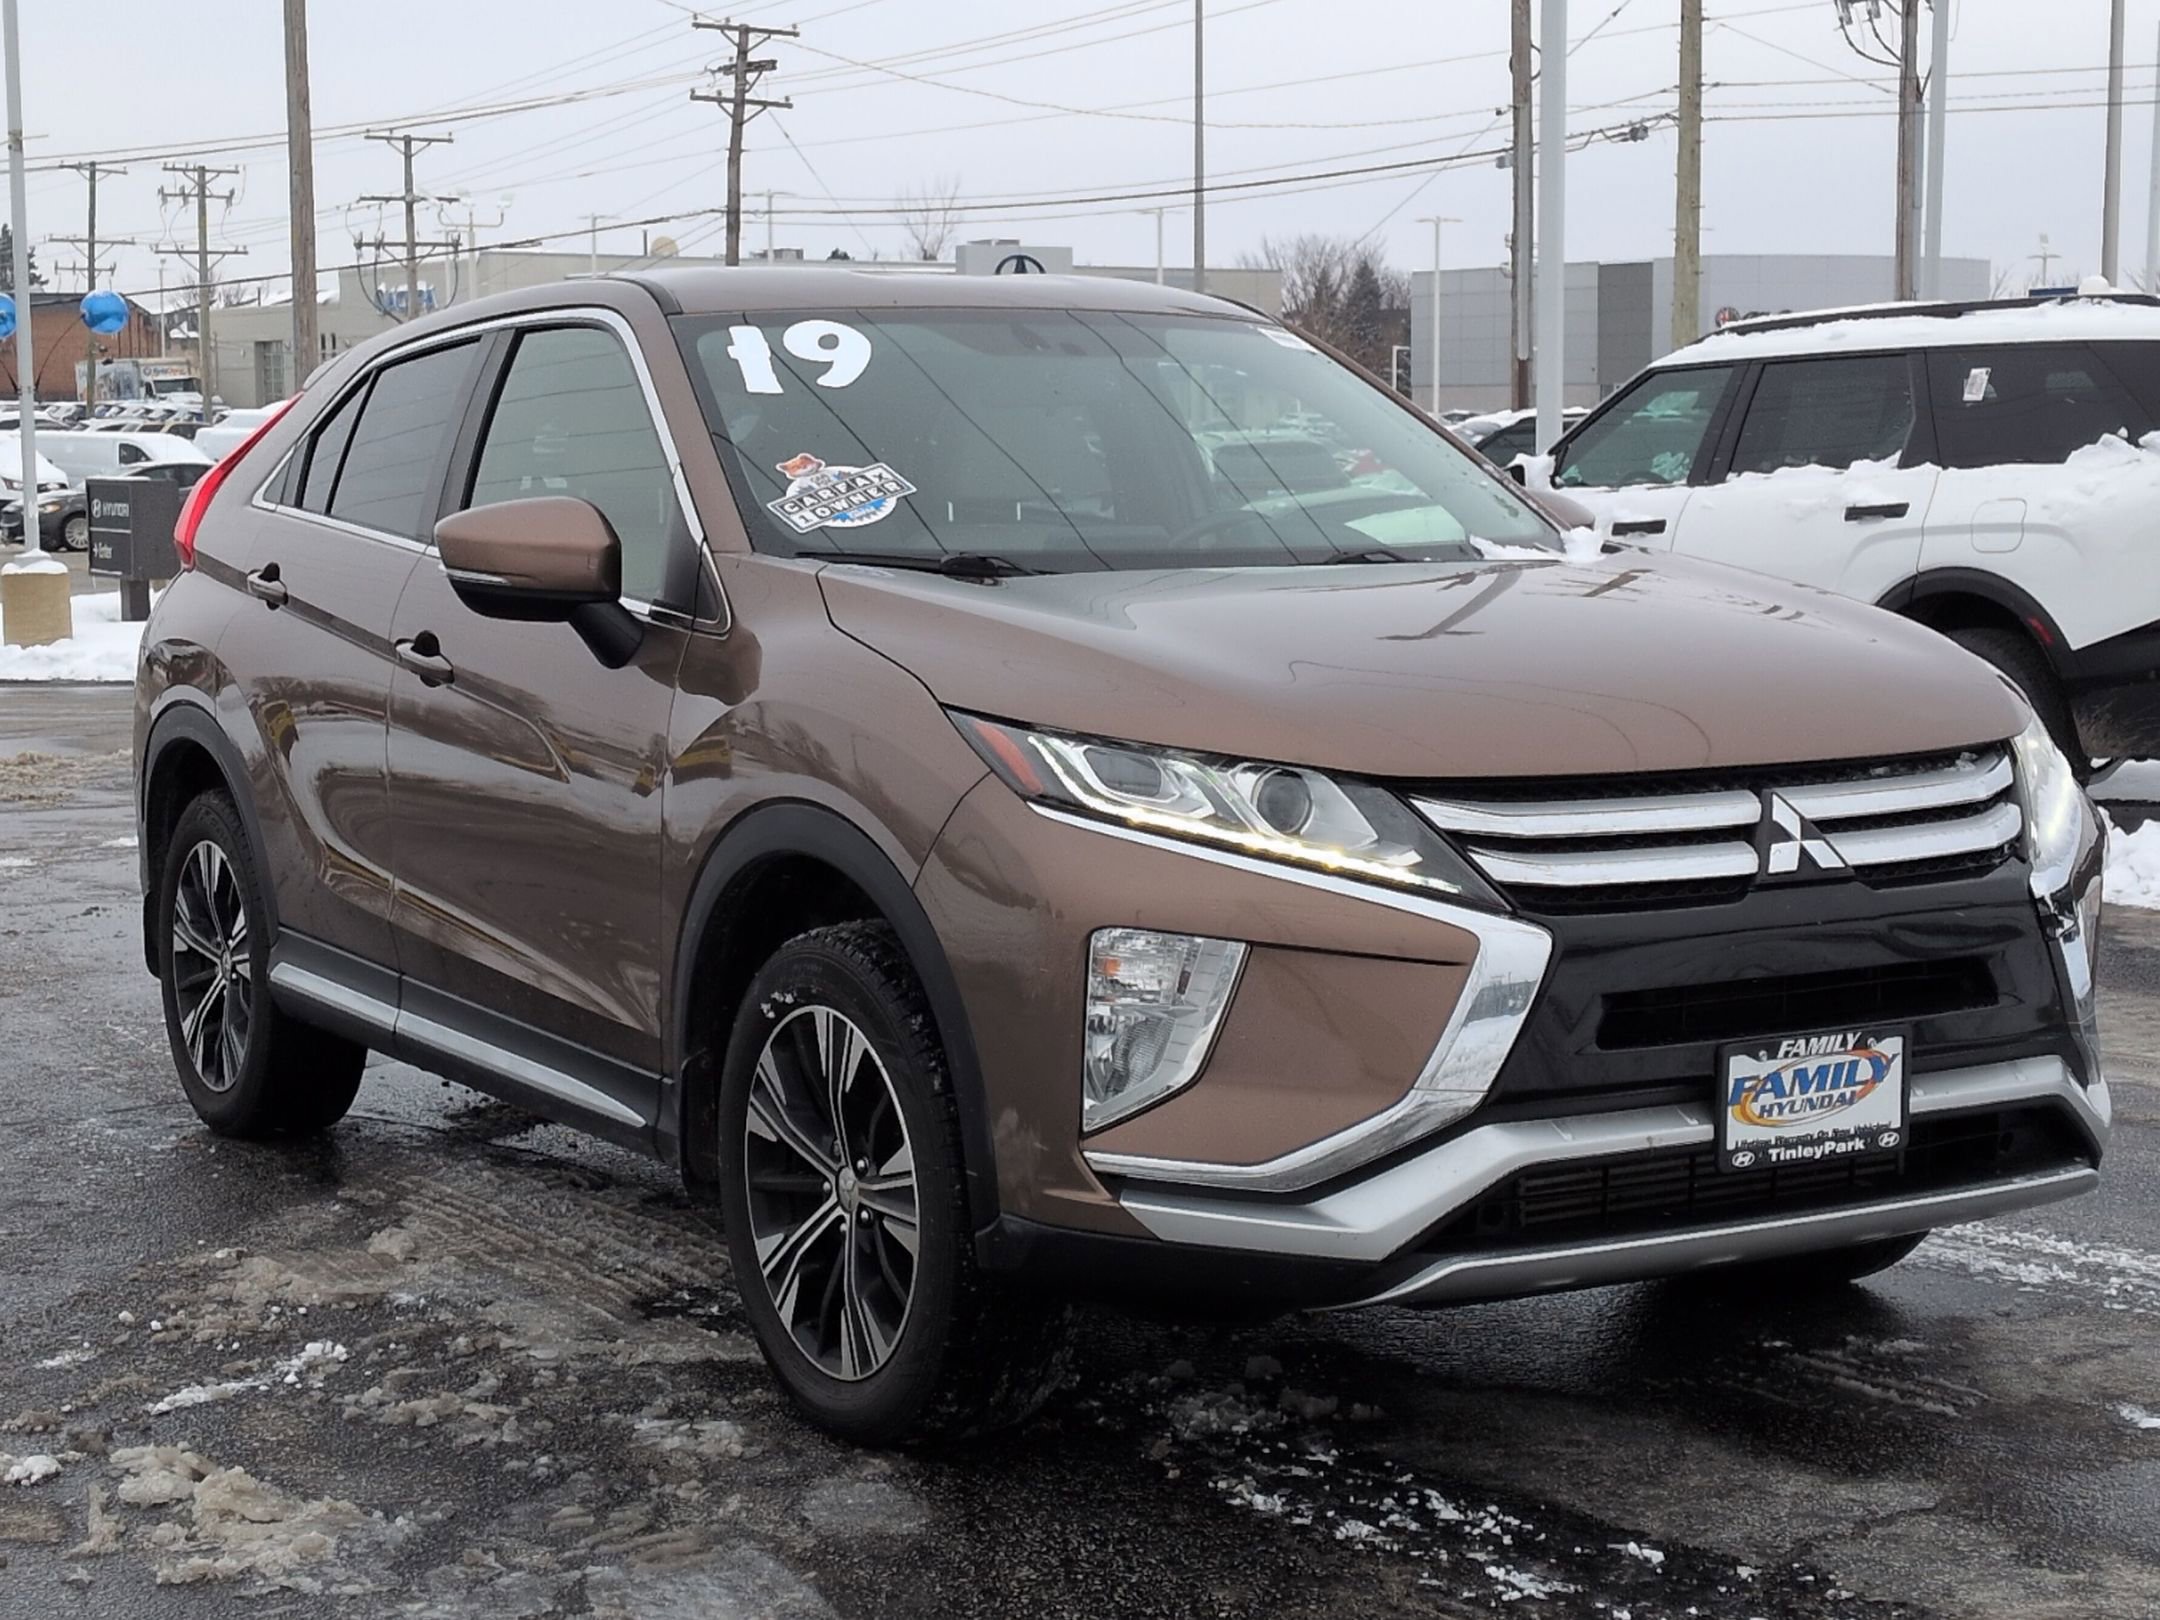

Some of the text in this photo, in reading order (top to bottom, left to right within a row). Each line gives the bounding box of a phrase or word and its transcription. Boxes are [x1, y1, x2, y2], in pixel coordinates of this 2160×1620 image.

[727, 319, 872, 394] 19
[783, 471, 890, 514] CARFAX
[798, 513, 813, 525] 1
[813, 481, 902, 519] OWNER
[1776, 1032, 1862, 1059] FAMILY
[1728, 1053, 1900, 1106] FAMILY
[1759, 1090, 1858, 1119] HYUNDAI
